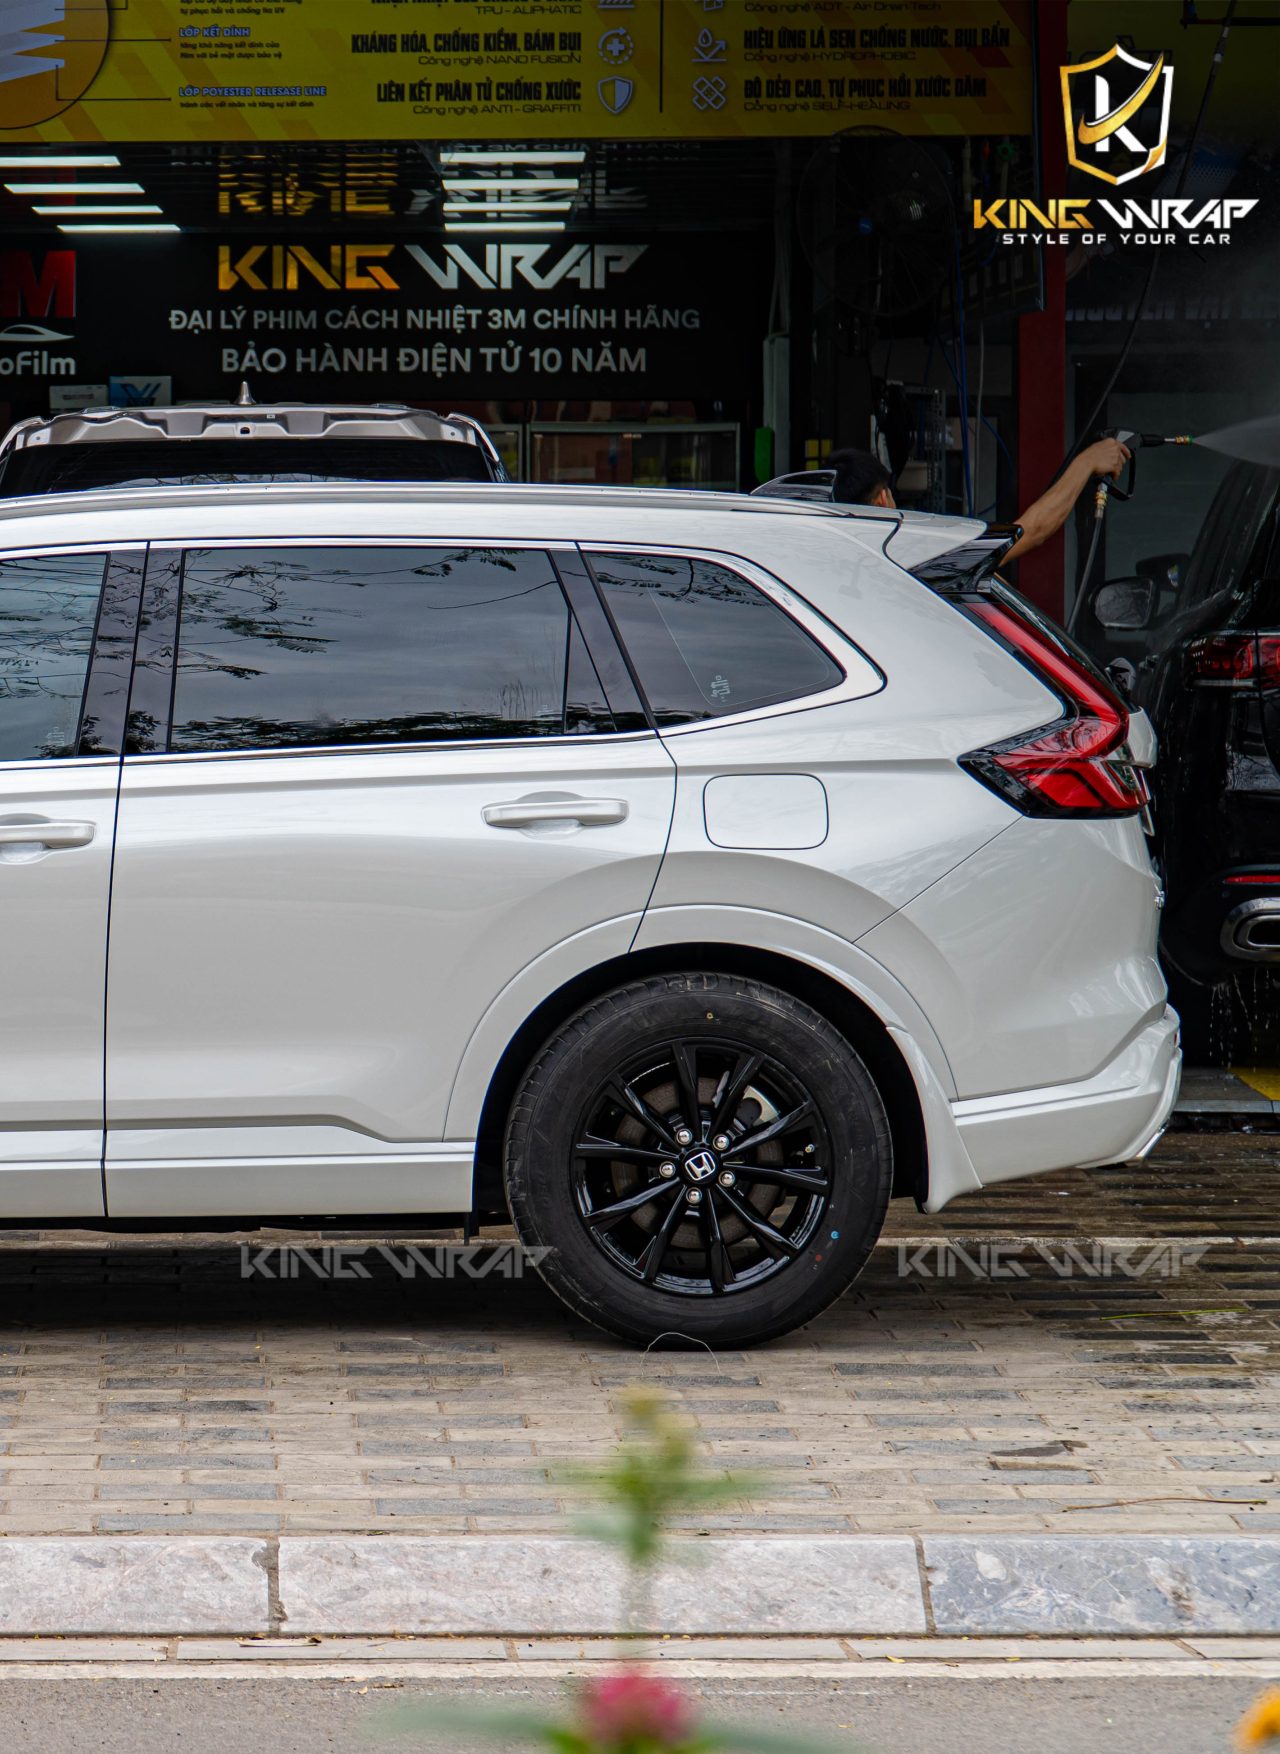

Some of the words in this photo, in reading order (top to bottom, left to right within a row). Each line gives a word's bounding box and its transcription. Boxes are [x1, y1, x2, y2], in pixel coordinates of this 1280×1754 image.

[475, 5, 504, 15] TPU
[513, 5, 582, 15] ALIPHATIC
[351, 30, 397, 53] KHÁNG
[434, 27, 480, 52] CHỐNG
[524, 29, 555, 51] BÁM
[418, 55, 452, 66] Công
[486, 55, 528, 64] NANO
[530, 54, 582, 64] FUSION
[202, 87, 252, 97] POYESTER
[304, 86, 327, 96] LINE
[376, 80, 406, 102] LIÊN
[409, 77, 432, 101] KẾT
[435, 79, 472, 101] PHÂN
[496, 75, 542, 100] CHỐNG
[413, 105, 447, 116] Công
[480, 104, 513, 113] ANTI
[523, 104, 582, 113] GRAFFITI
[217, 244, 401, 290] KING
[403, 244, 649, 290] WRAP
[169, 308, 213, 335] ĐẠI
[220, 305, 247, 330] LÝ
[253, 309, 318, 330] PHIM
[324, 305, 399, 330] CÁCH
[406, 305, 483, 334] NHIỆT
[487, 308, 526, 330] 3M
[532, 304, 617, 330] CHÍNH
[624, 304, 701, 330] HÃNG
[222, 340, 288, 374] BẢO
[295, 343, 389, 374] HÀNH
[397, 341, 471, 378] ĐIỆN
[479, 339, 522, 374] TỬ
[529, 347, 563, 373] 10
[571, 340, 647, 374] NĂM
